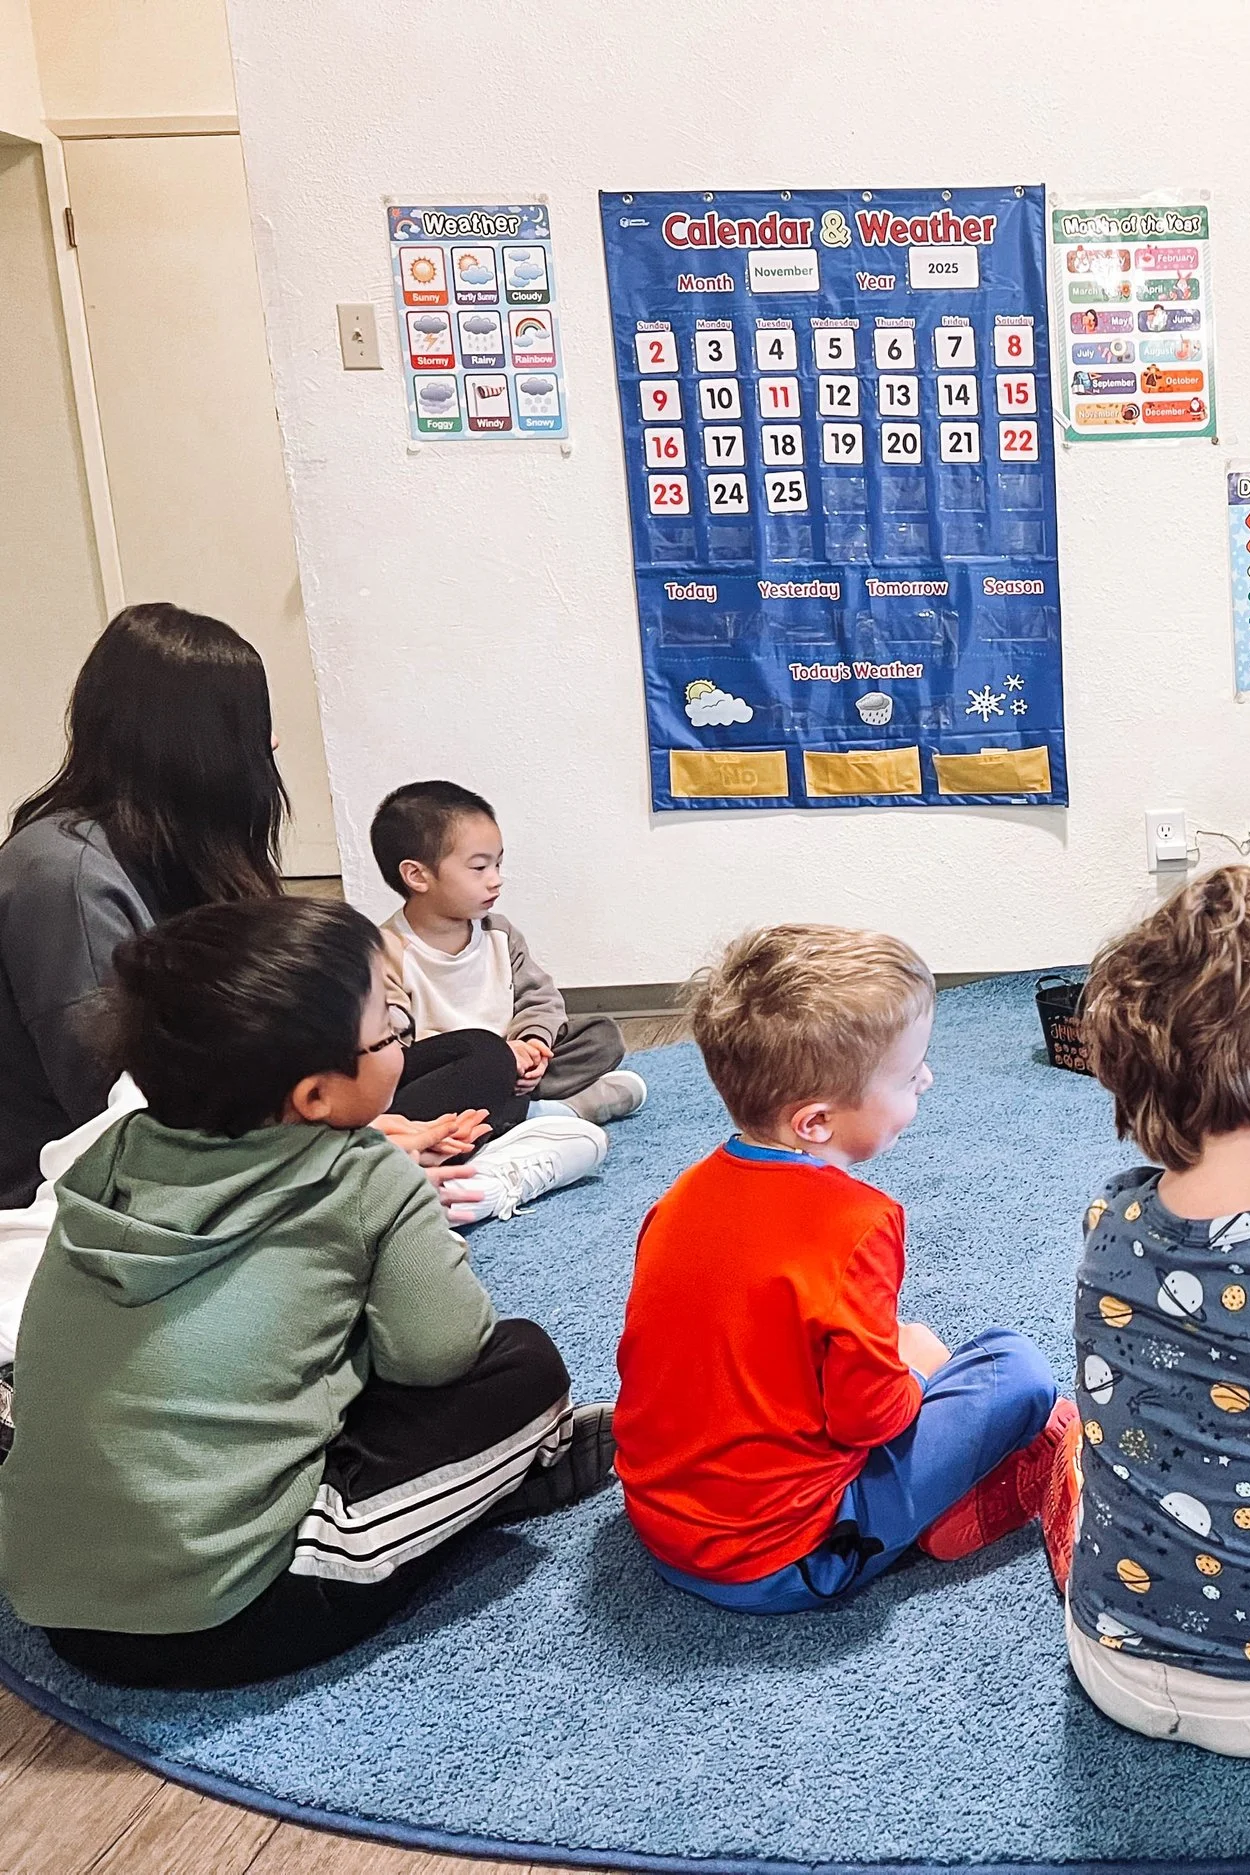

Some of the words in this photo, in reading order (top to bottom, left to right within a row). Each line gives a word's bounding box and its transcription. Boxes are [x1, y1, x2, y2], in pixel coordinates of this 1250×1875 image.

[423, 212, 520, 237] Weather
[663, 212, 813, 248] Calendar
[820, 211, 850, 247] &
[856, 210, 996, 245] Weather
[1121, 215, 1138, 234] of
[1140, 214, 1165, 235] the
[1165, 213, 1201, 232] Year
[1157, 253, 1195, 264] February
[754, 266, 814, 278] November
[928, 262, 959, 274] 2025
[679, 275, 733, 291] Month
[857, 273, 896, 290] Year
[1142, 284, 1163, 295] April
[412, 292, 441, 303] Sunny
[457, 292, 474, 302] Partly
[475, 292, 498, 303] Sunny
[511, 291, 543, 302] Cloudy
[1072, 287, 1098, 296] March
[638, 321, 671, 331] Sunday
[697, 320, 731, 330] Monday
[757, 319, 792, 329] Tuesday
[811, 318, 859, 328] Wednesday
[875, 318, 915, 328] Thursday
[942, 317, 969, 327] Friday
[995, 316, 1034, 326] Saturday
[1111, 316, 1128, 327] May
[1172, 315, 1193, 324] June
[649, 341, 665, 363] 2
[708, 340, 723, 362] 3
[768, 338, 784, 360] 4
[828, 337, 842, 359] 5
[887, 338, 902, 360] 6
[947, 336, 962, 357] 7
[1007, 335, 1022, 357] 8
[1077, 348, 1095, 359] July
[1143, 347, 1174, 358] August
[417, 356, 449, 367] Stormy
[471, 355, 497, 366] Rainy
[515, 354, 553, 364] Rainbow
[1092, 379, 1136, 389] September
[1165, 376, 1199, 385] October
[652, 389, 668, 411] 9
[706, 387, 733, 409] 10
[769, 386, 790, 408] 11
[826, 384, 851, 407] 12
[886, 384, 911, 406] 13
[944, 383, 970, 406] 14
[1003, 382, 1030, 405] 15
[1080, 410, 1119, 419] November
[1145, 408, 1186, 417] December
[427, 419, 454, 430] Foggy
[477, 418, 504, 429] Windy
[526, 417, 555, 428] Snowy
[652, 436, 679, 458] 16
[712, 435, 737, 457] 17
[770, 434, 796, 456] 18
[831, 432, 856, 454] 19
[887, 432, 917, 454] 20
[949, 431, 972, 453] 21
[1003, 430, 1033, 451] 22
[653, 483, 684, 505] 23
[713, 482, 744, 504] 24
[772, 481, 802, 503] 25
[665, 583, 717, 602] Today
[758, 582, 841, 600] Yesterday
[866, 580, 948, 596] Tomorrow
[983, 578, 1044, 595] Season
[790, 663, 851, 681] Today's
[853, 662, 923, 678] Weather
